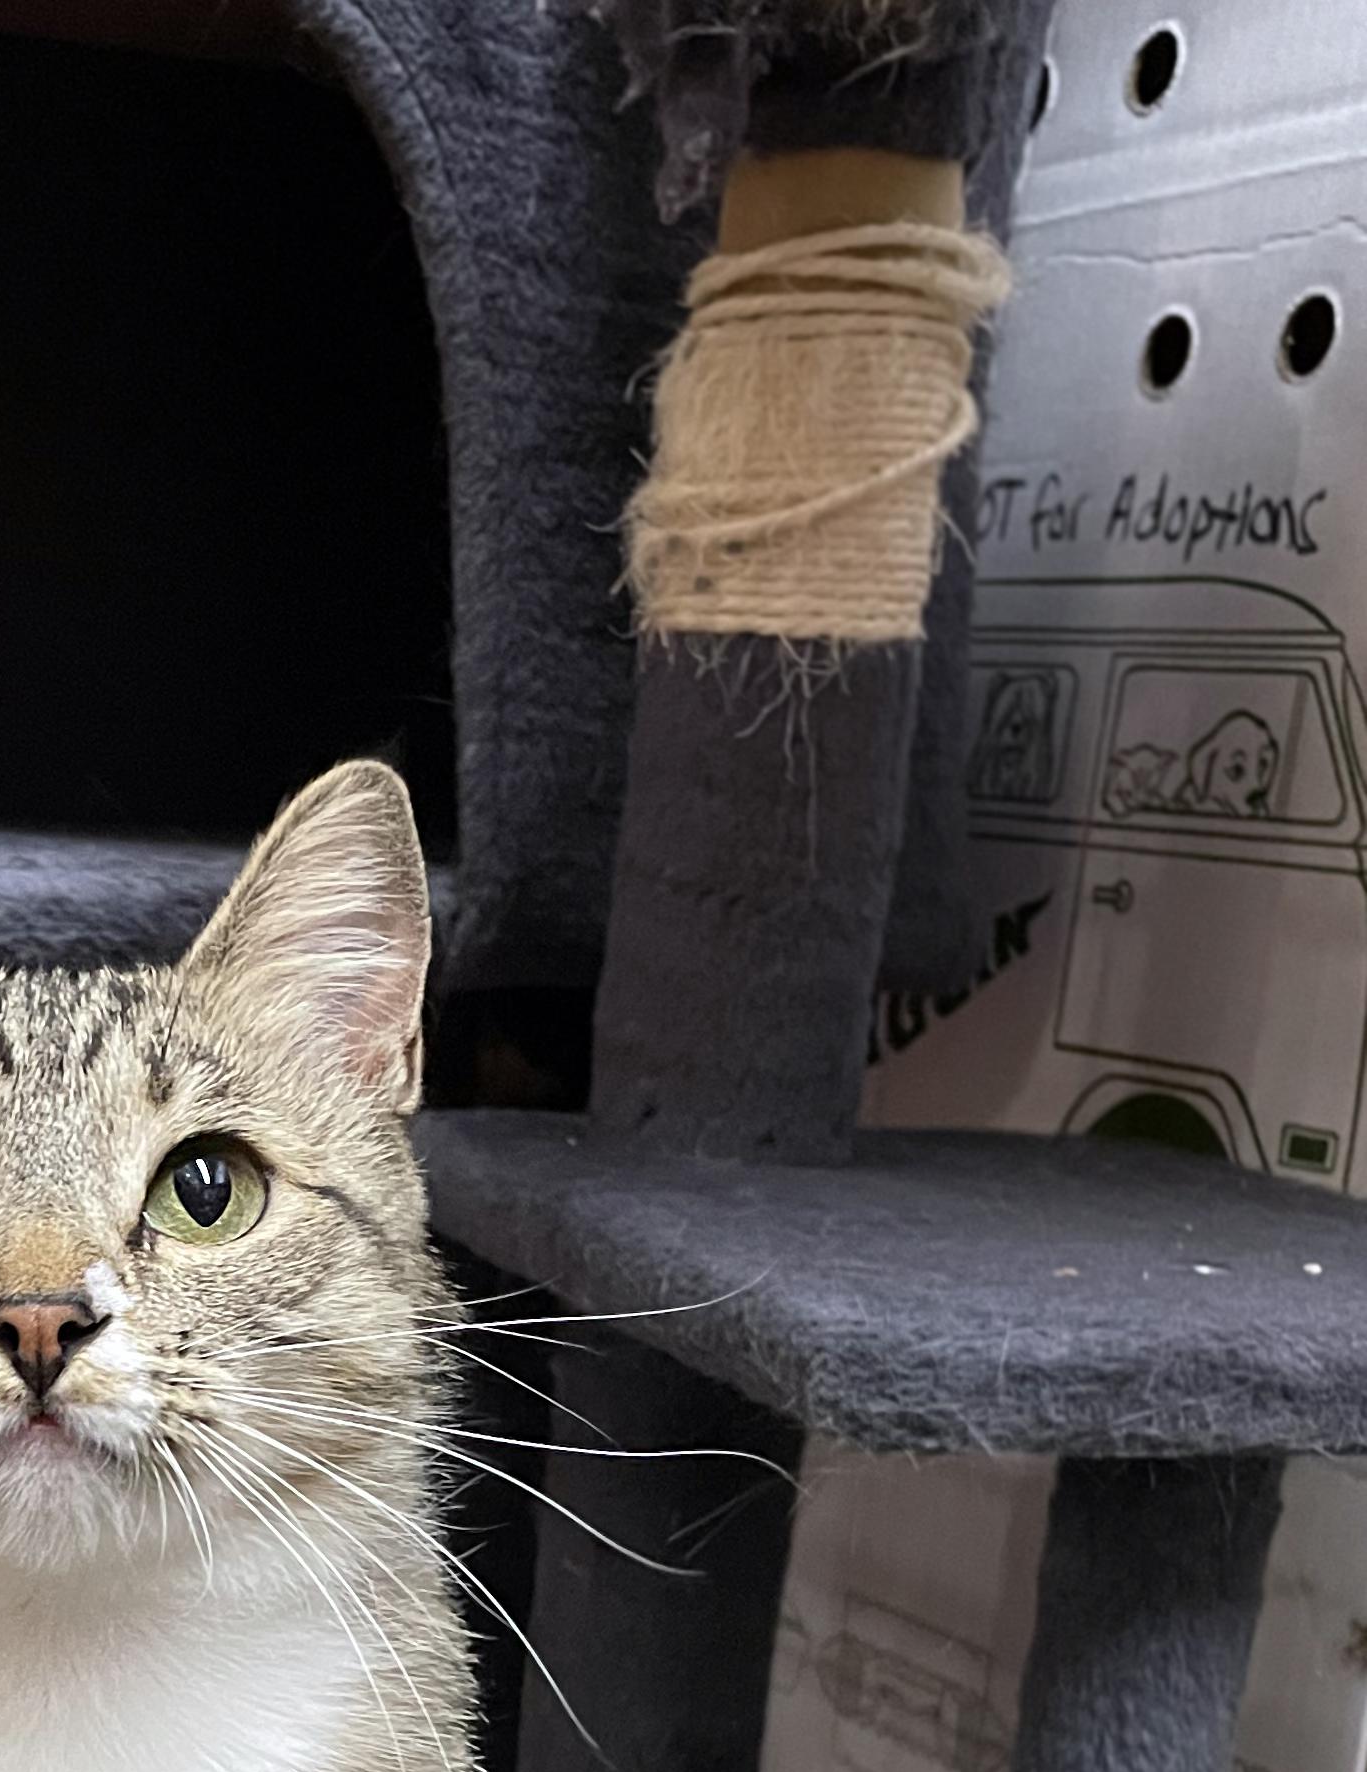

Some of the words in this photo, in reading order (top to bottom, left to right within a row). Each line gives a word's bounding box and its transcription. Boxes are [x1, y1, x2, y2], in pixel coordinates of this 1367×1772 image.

[975, 476, 1027, 543] OT
[1029, 470, 1089, 553] for
[1104, 472, 1327, 564] Adoptions
